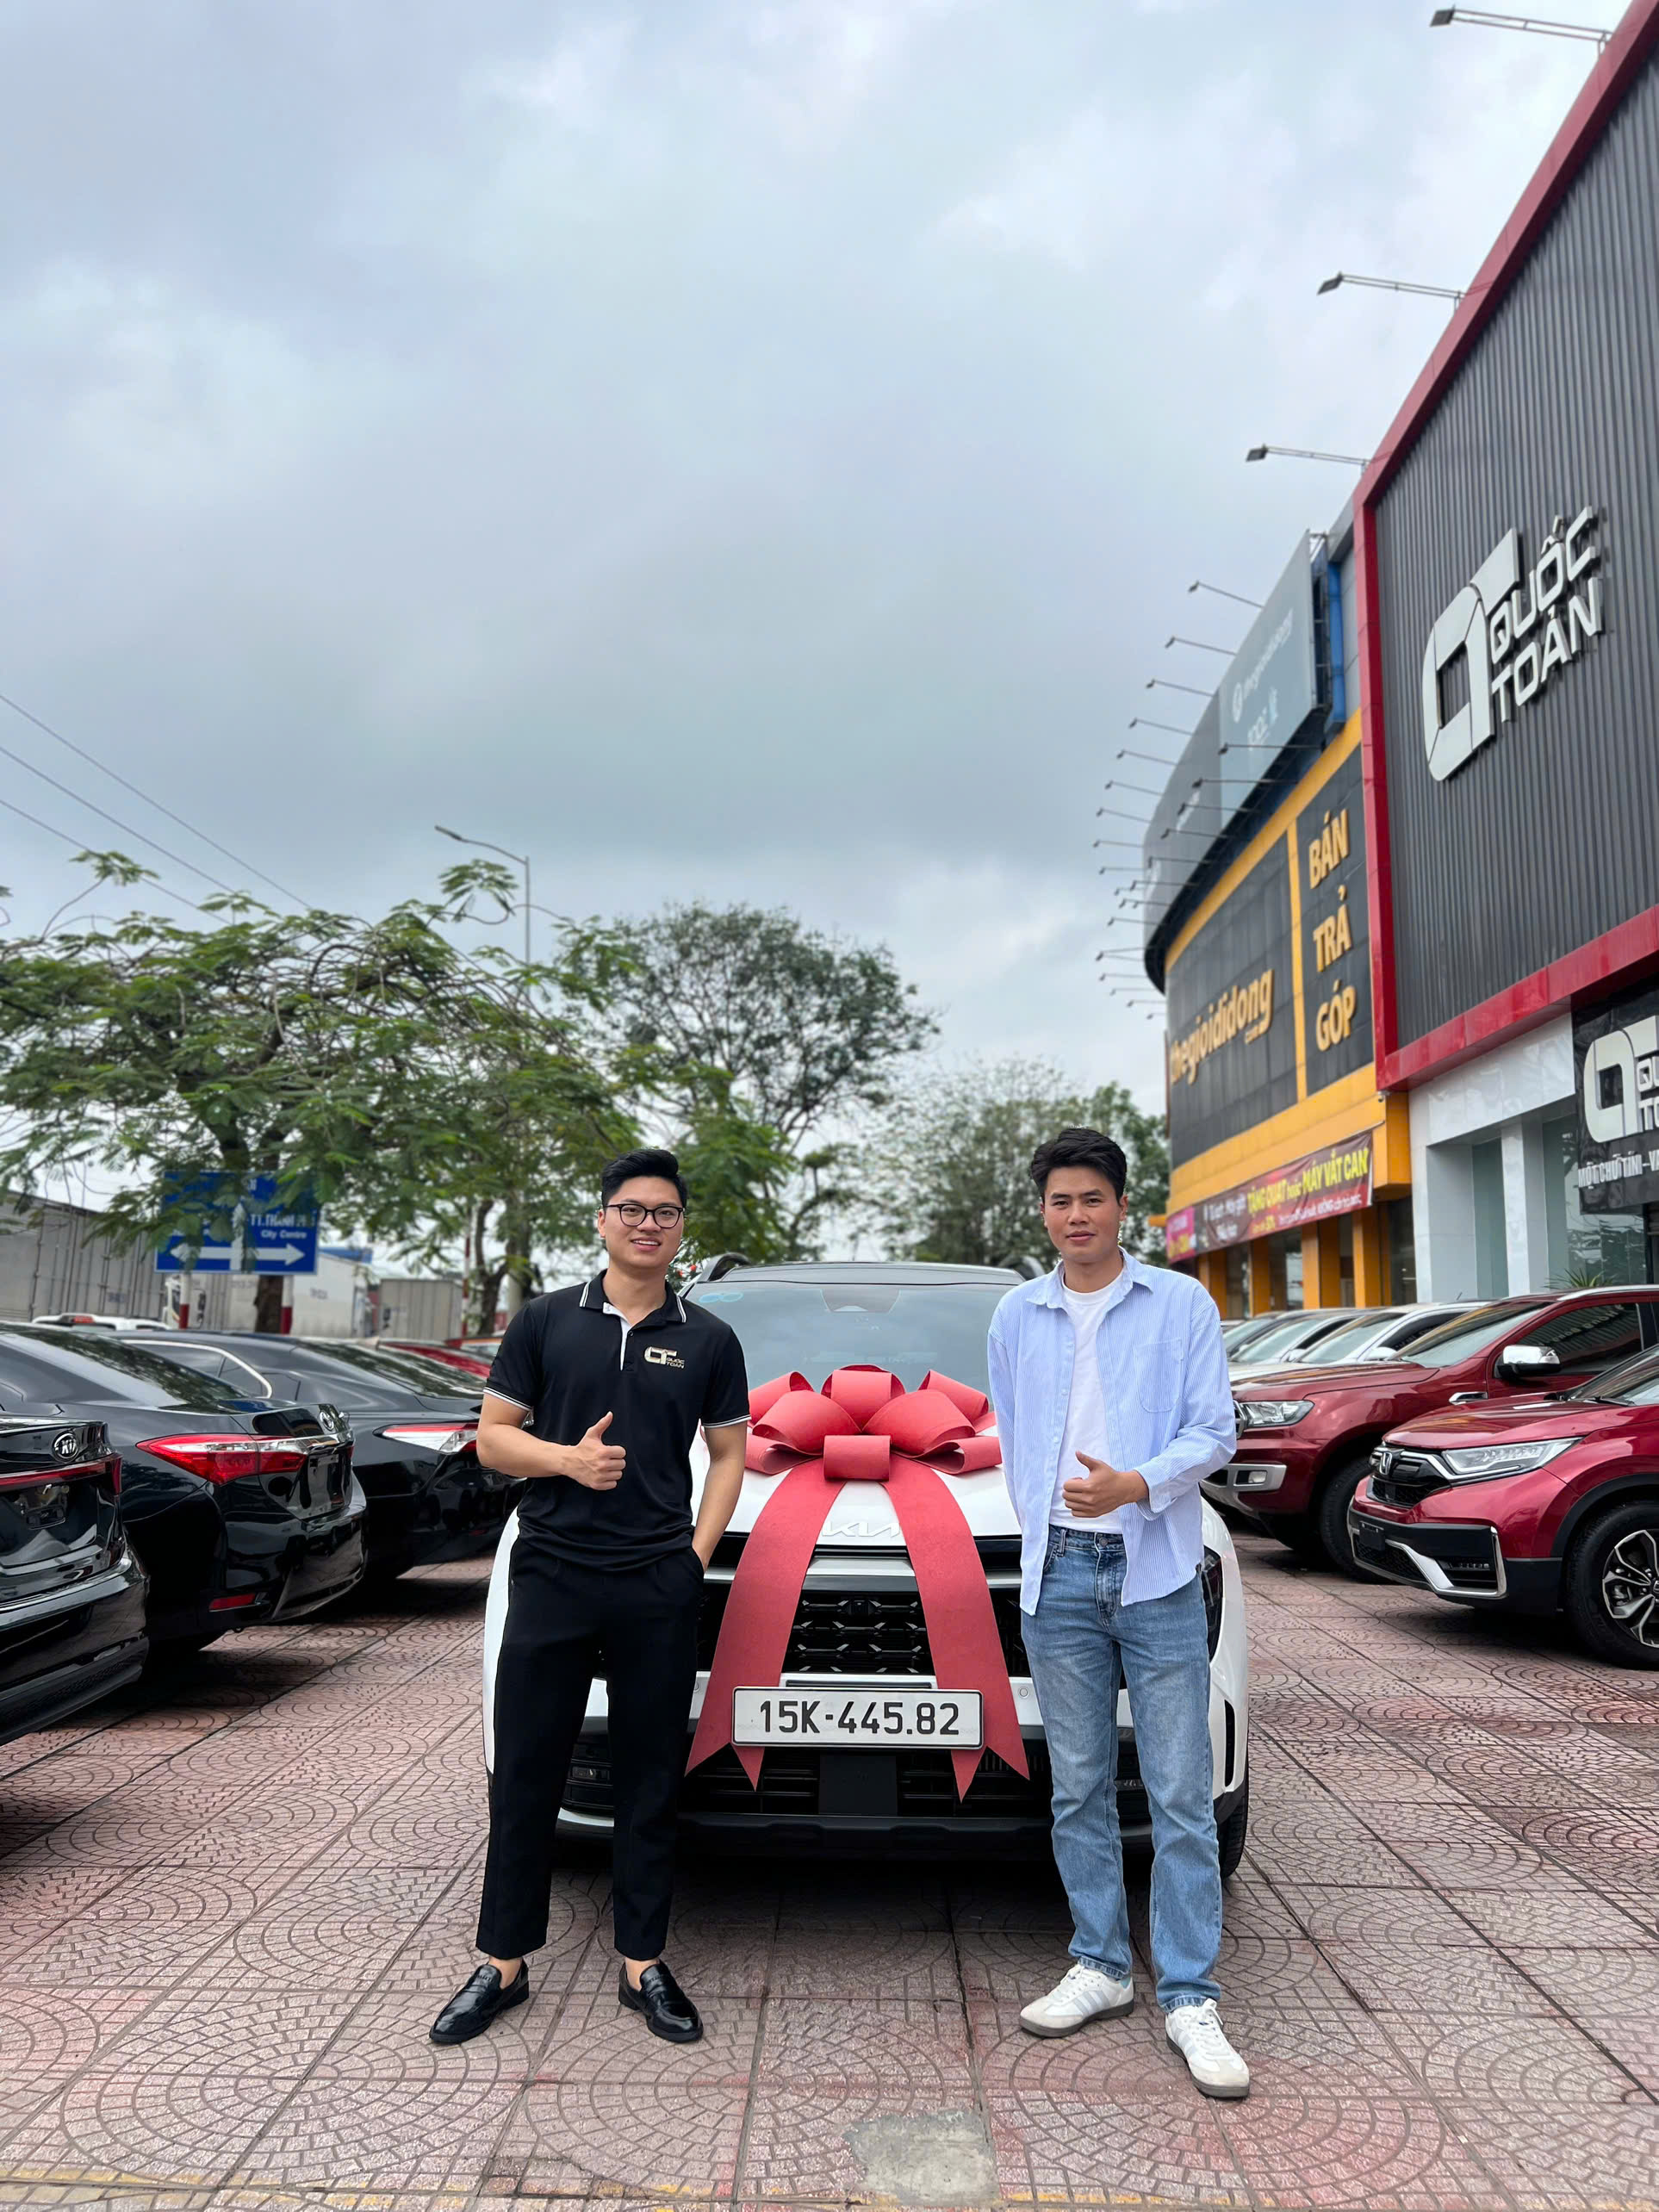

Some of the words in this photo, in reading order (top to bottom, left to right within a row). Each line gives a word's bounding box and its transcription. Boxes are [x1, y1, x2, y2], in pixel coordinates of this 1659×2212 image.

[1490, 506, 1595, 664] QUỐC
[1308, 809, 1350, 890] BÁN
[1314, 885, 1352, 972] TRẢ
[1316, 979, 1357, 1052] GÓP
[261, 1229, 277, 1240] City
[760, 1700, 960, 1736] 15K-445.82
